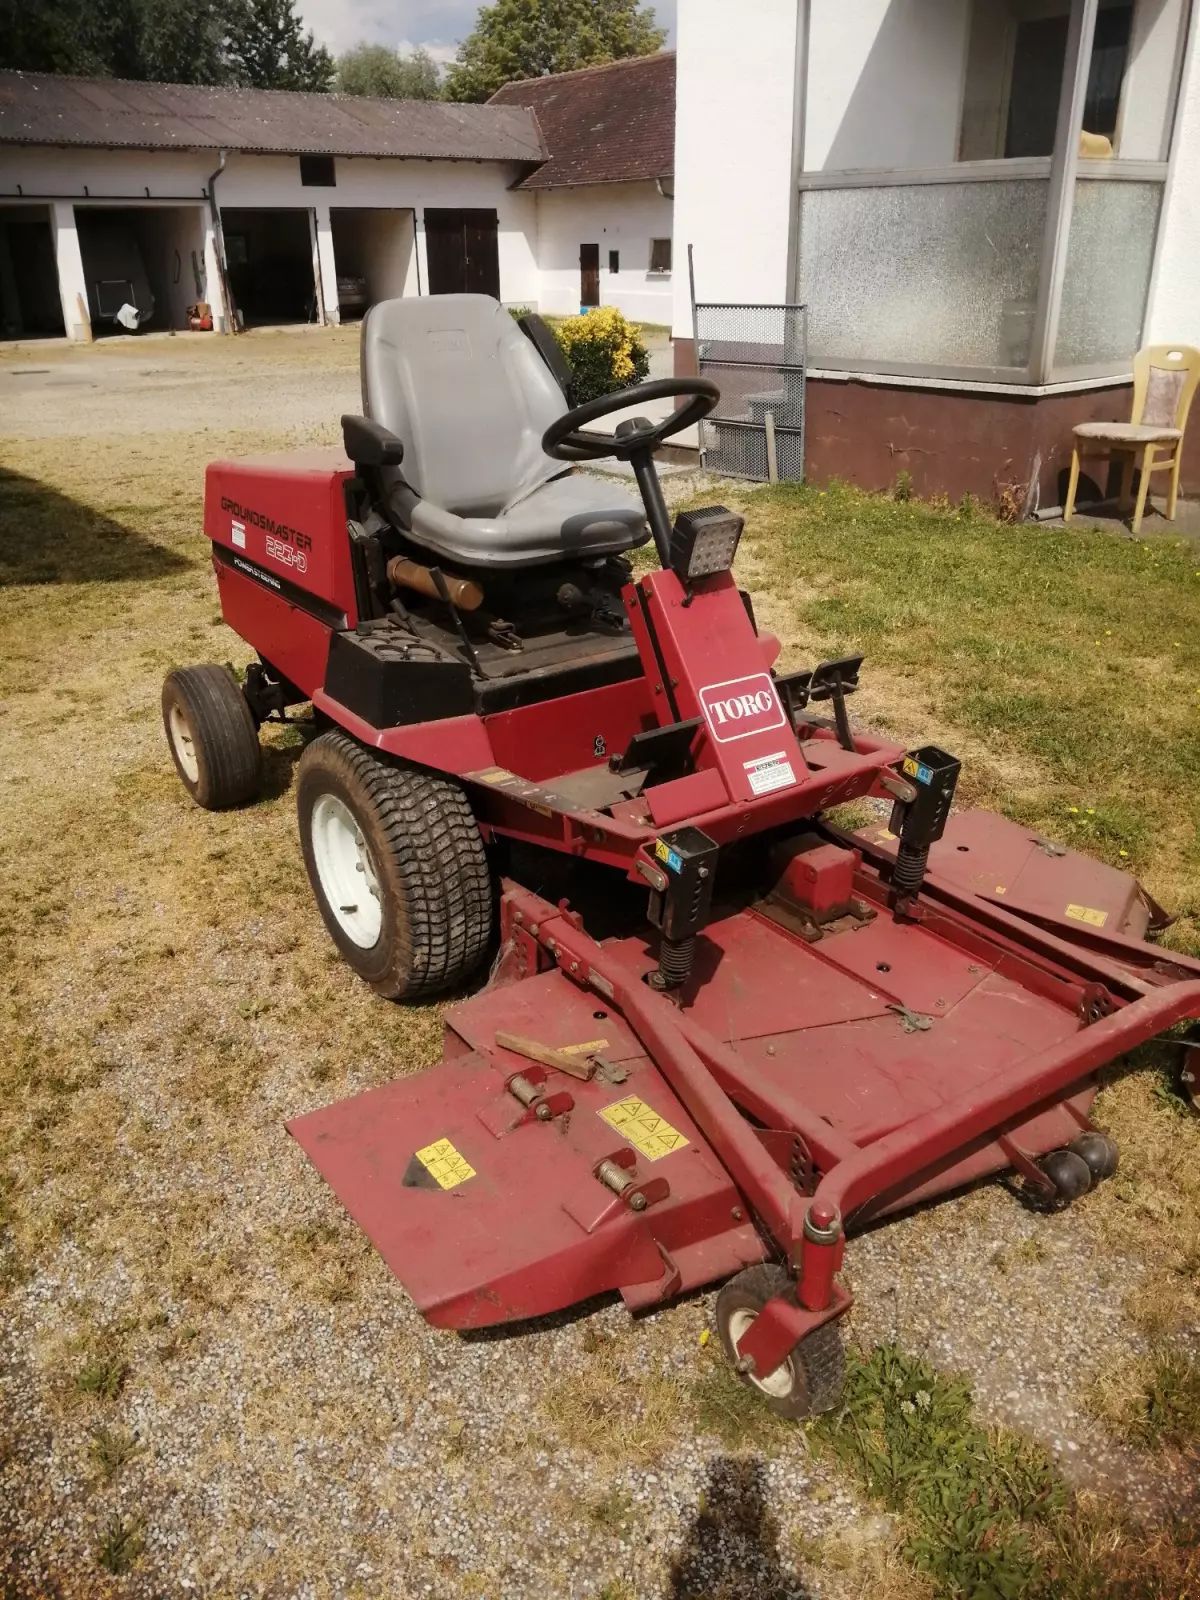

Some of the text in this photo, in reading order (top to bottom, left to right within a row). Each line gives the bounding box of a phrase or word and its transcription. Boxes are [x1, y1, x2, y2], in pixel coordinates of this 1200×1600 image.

[221, 496, 312, 552] GROUNDSMASTER
[266, 535, 307, 574] 223-D
[709, 690, 773, 724] TORO
